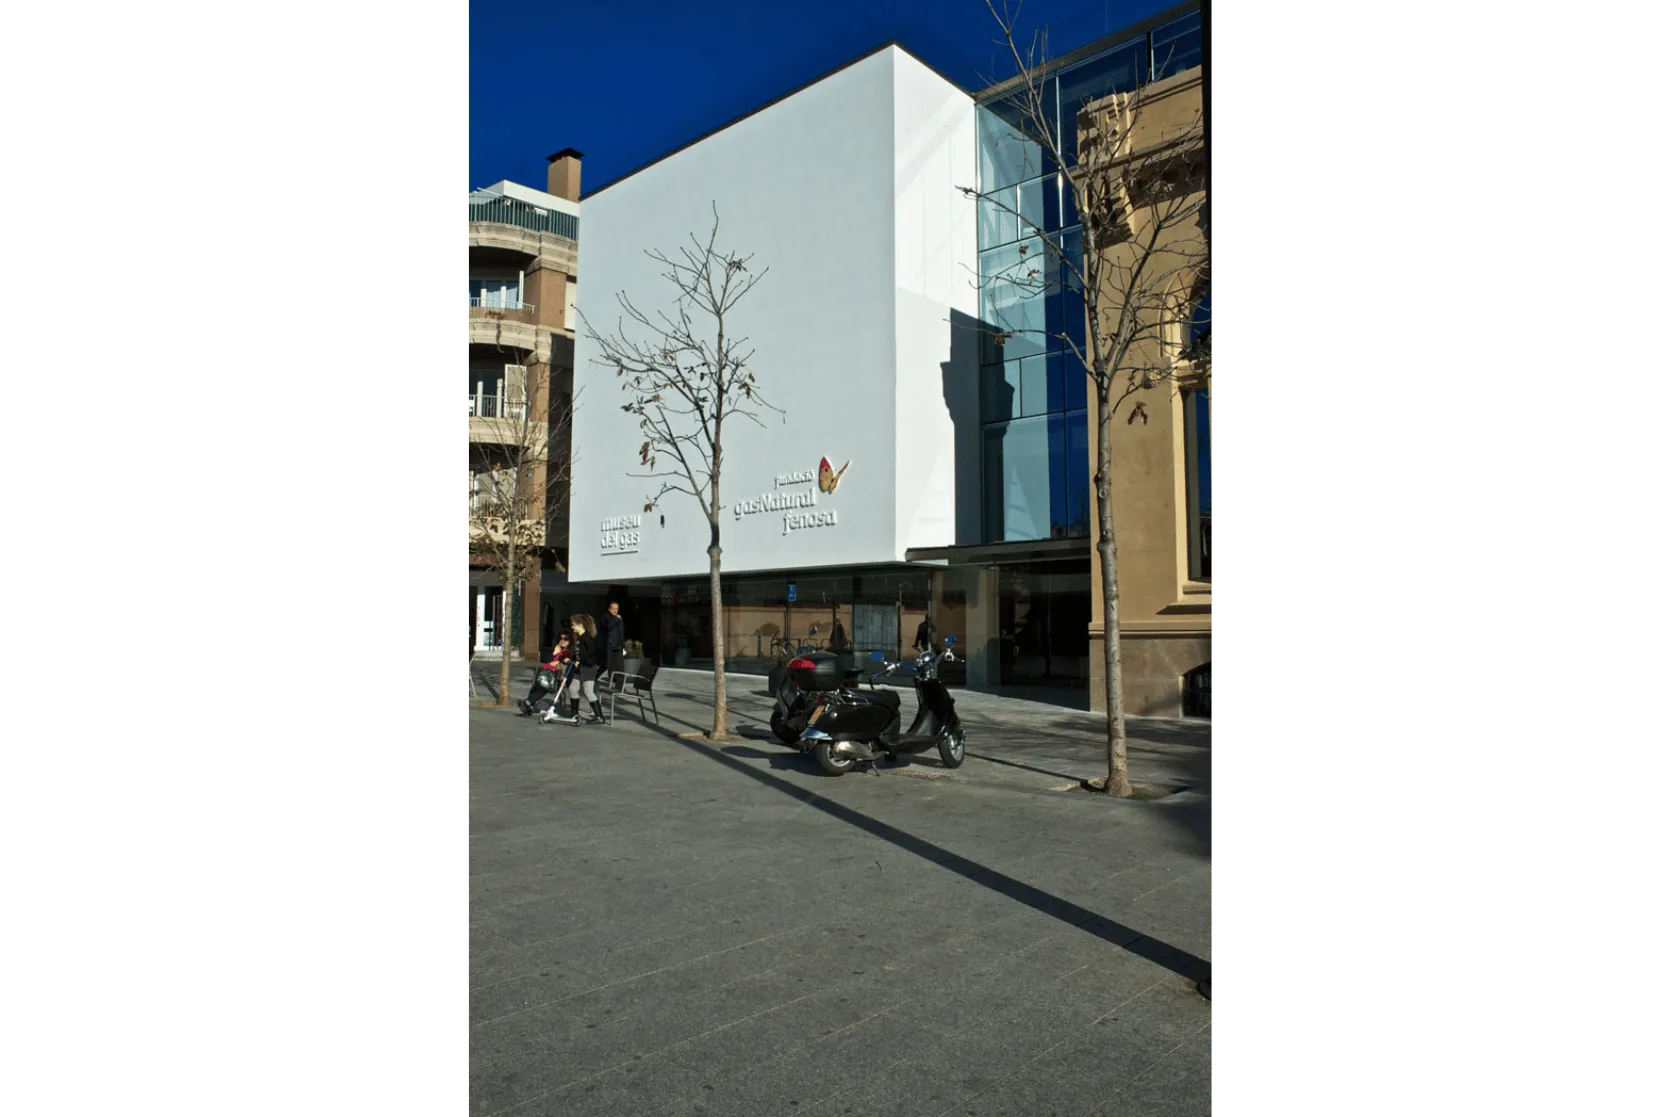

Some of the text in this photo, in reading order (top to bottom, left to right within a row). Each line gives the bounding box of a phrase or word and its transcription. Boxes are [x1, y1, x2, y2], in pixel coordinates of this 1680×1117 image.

[600, 515, 641, 532] museu
[782, 510, 838, 536] fenosa
[600, 530, 640, 551] del gas
